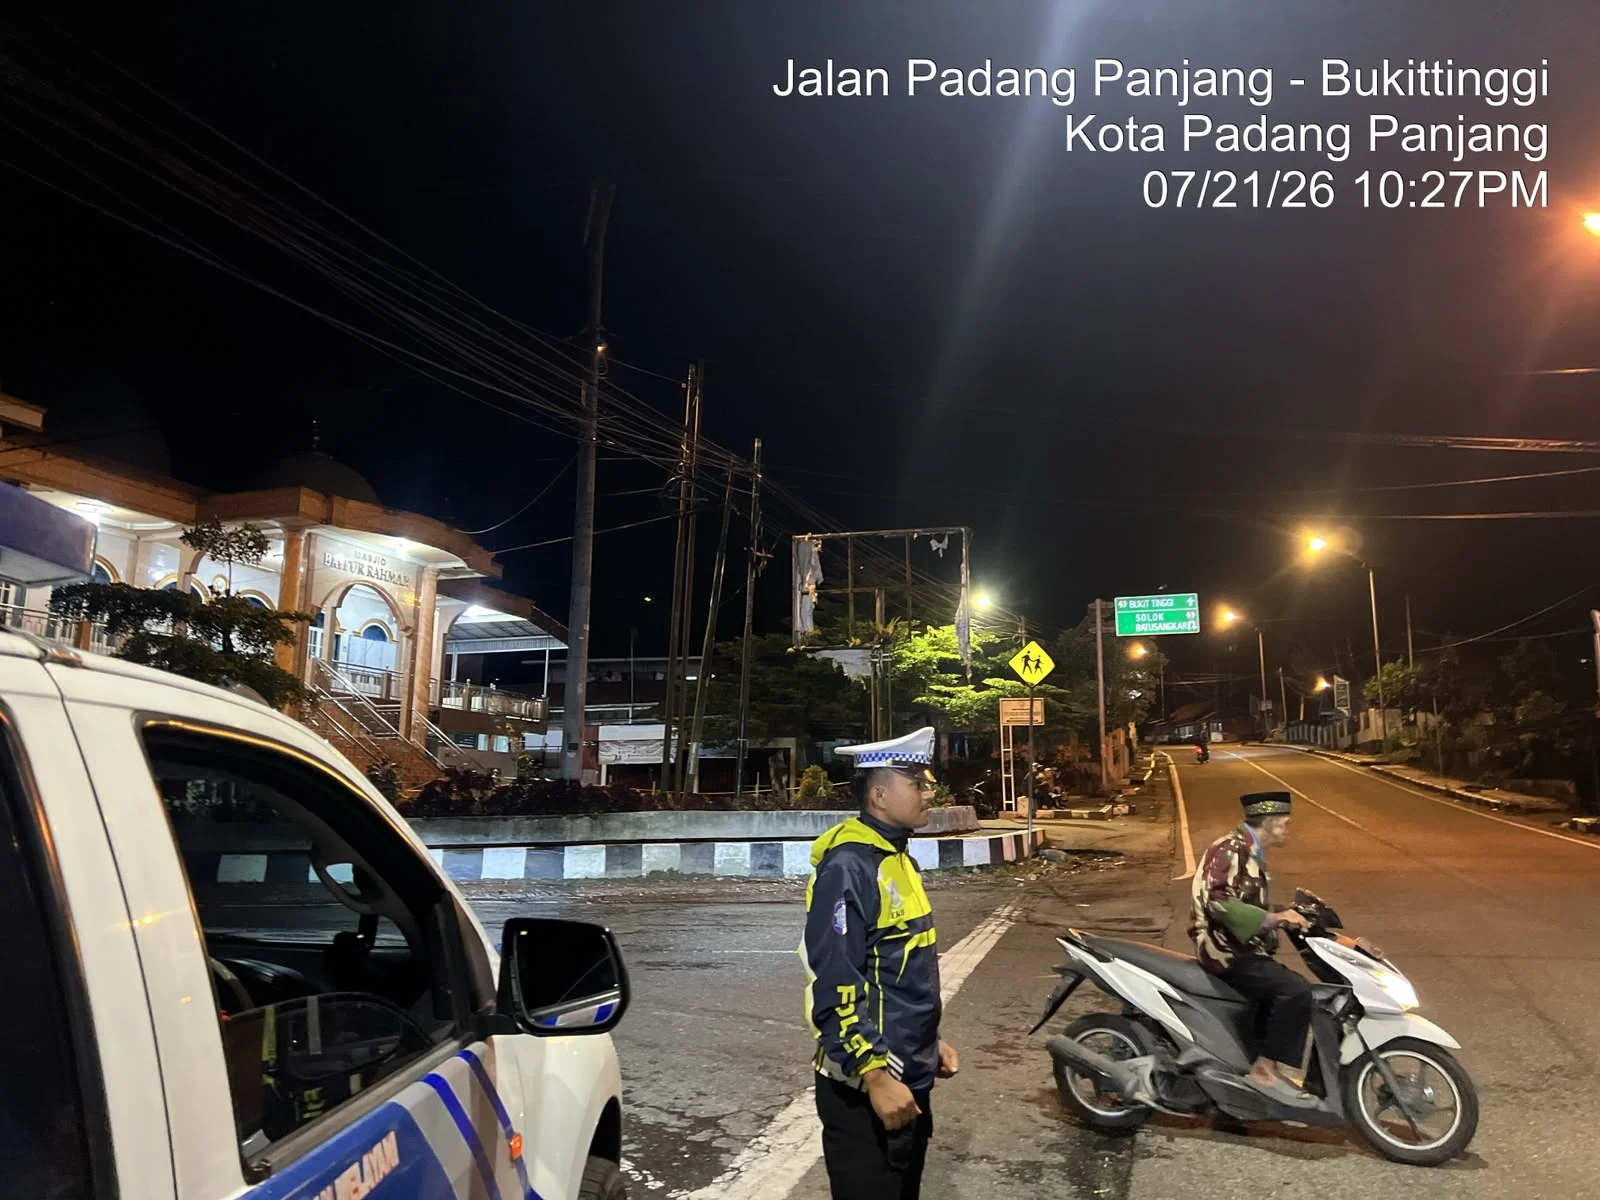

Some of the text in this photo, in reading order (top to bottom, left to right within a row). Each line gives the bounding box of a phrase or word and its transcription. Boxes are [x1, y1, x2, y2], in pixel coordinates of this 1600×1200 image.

[354, 551, 387, 566] MASJID
[366, 565, 411, 587] RAHMAN
[1128, 598, 1174, 608] BUKIT TINGGI
[1135, 613, 1165, 622] SOLOK
